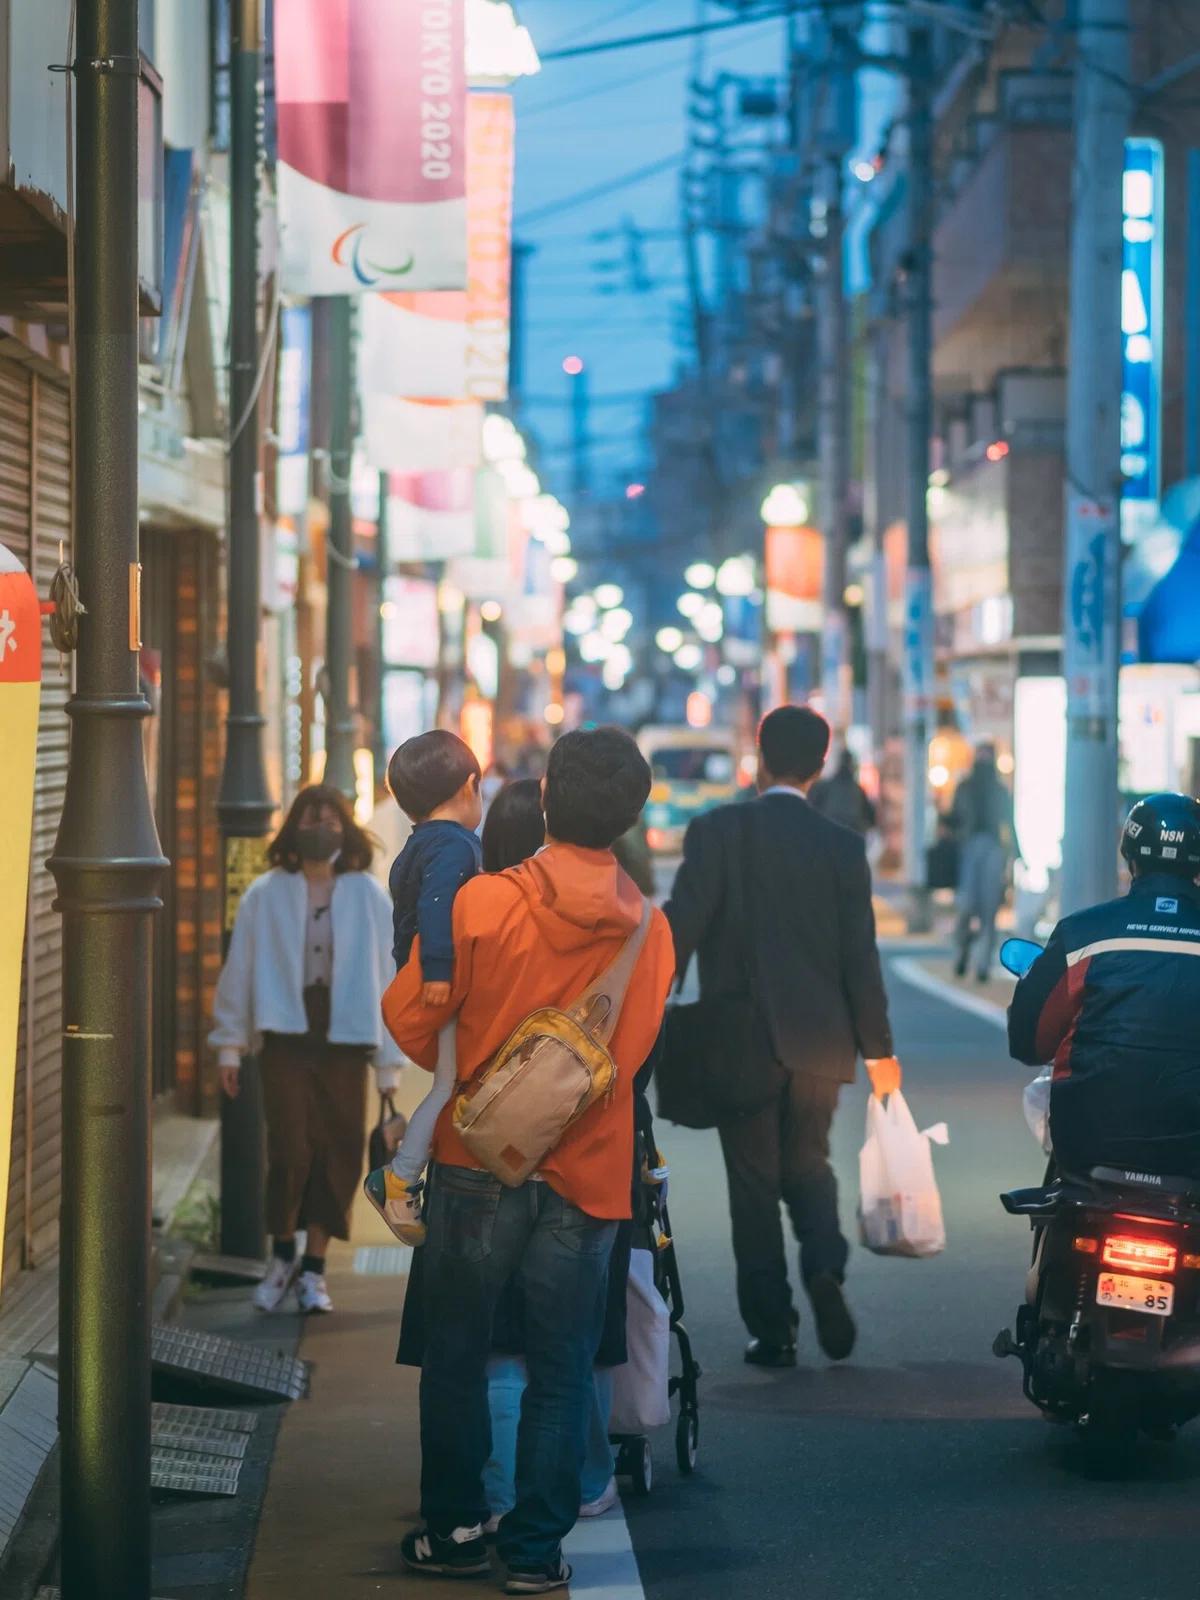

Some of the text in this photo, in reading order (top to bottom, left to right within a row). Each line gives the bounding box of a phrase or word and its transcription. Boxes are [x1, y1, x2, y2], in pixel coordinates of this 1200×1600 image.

[420, 102, 452, 180] 2020
[464, 275, 508, 400] 2020
[1160, 829, 1184, 842] NSN
[1148, 925, 1179, 934] SERVICE
[1125, 1171, 1161, 1185] YAMAHA
[1144, 1294, 1168, 1310] 85
